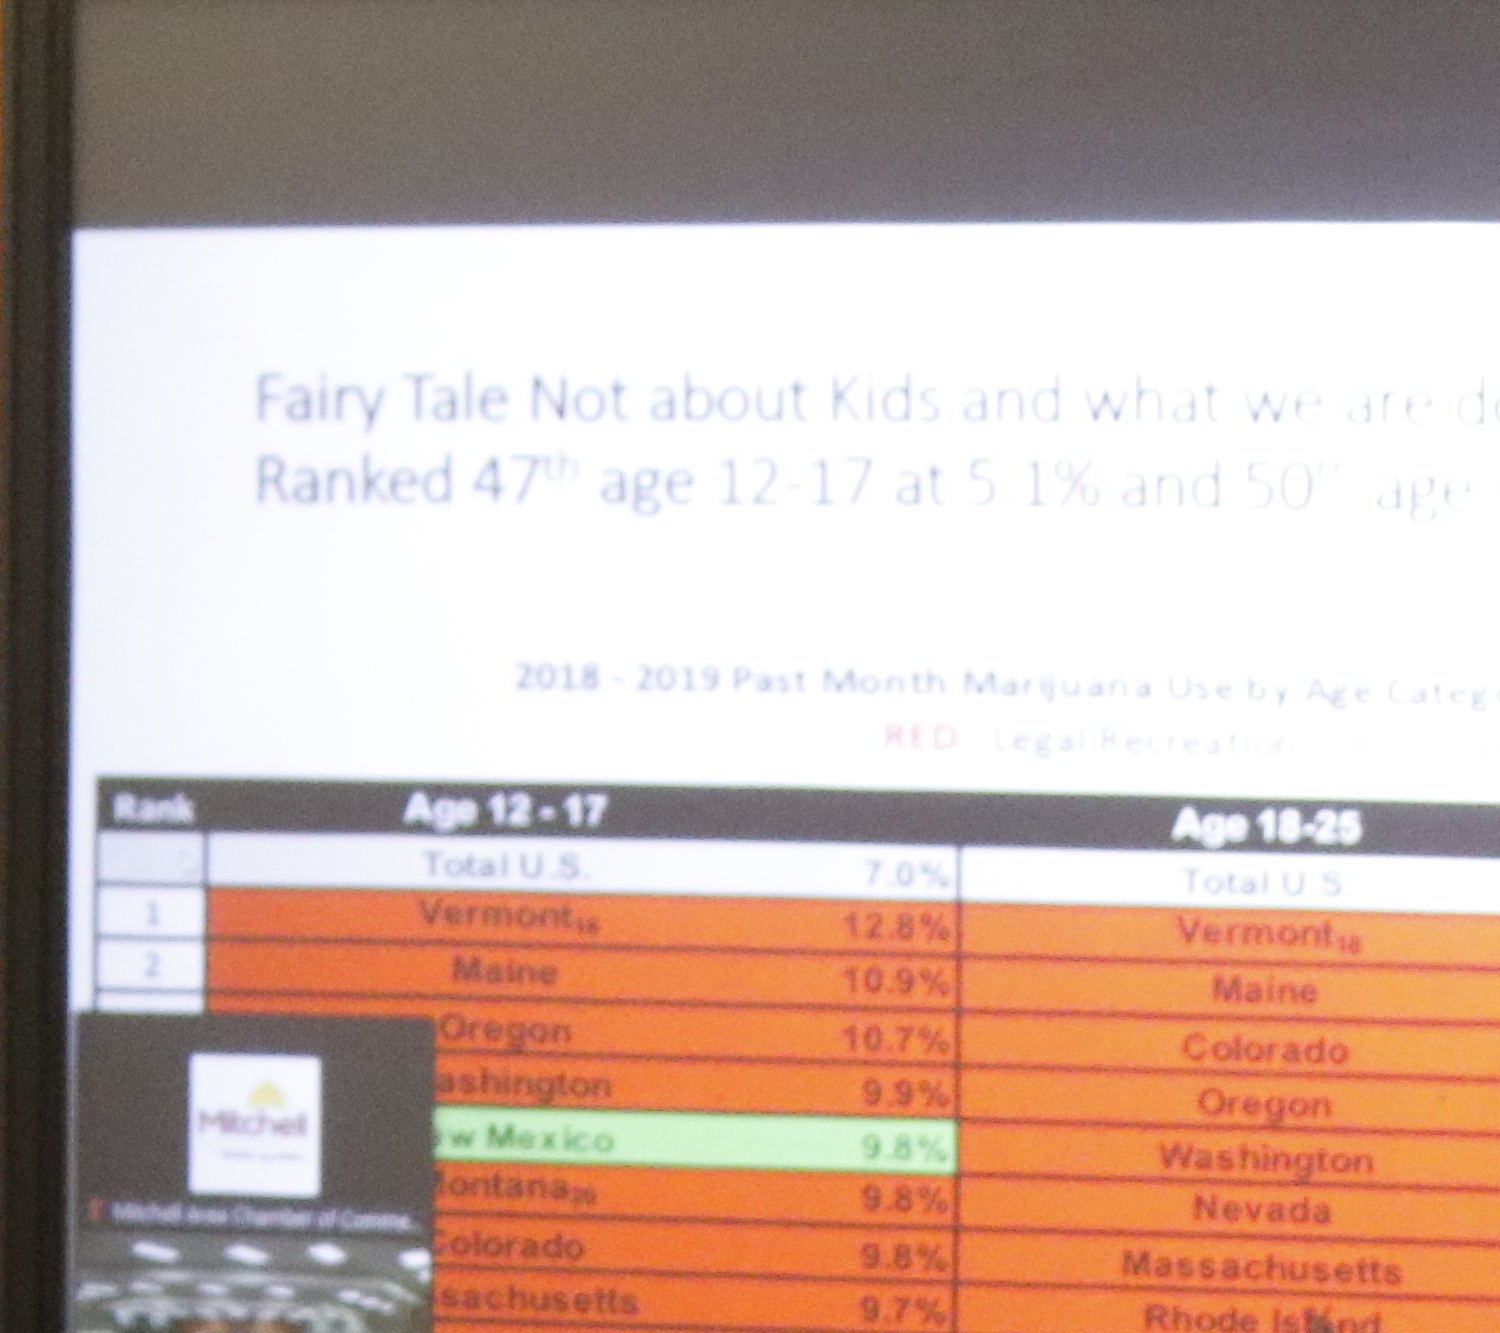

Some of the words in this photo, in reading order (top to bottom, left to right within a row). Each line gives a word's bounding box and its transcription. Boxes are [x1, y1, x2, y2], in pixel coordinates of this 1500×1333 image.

[253, 370, 387, 435] Fairy
[402, 371, 510, 424] Tale
[530, 373, 631, 424] Not
[649, 371, 808, 425] about
[829, 372, 942, 425] Kids
[960, 376, 1062, 425] and
[1084, 375, 1221, 426] what
[1242, 387, 1325, 427] we
[1345, 387, 1436, 427] are
[253, 452, 456, 508] Ranked
[472, 452, 581, 507] 47th
[599, 463, 697, 517] age
[717, 455, 874, 508] 12-17
[893, 459, 945, 508] at
[965, 455, 1101, 510] 5.1%
[1120, 456, 1222, 510] and
[1374, 474, 1473, 524] age
[514, 660, 602, 692] 2018
[634, 662, 722, 694] 2019
[731, 664, 808, 695] Past
[821, 666, 948, 697] Month
[961, 668, 1153, 705] Marijuana
[1166, 675, 1234, 702] Use
[1246, 674, 1292, 707] by
[1305, 676, 1373, 711] Age
[882, 721, 960, 752] RED
[112, 792, 195, 825] Rank
[403, 793, 480, 830] Age
[488, 794, 532, 826] 12
[565, 795, 608, 828] 17
[1171, 808, 1249, 850] Age
[1256, 809, 1363, 846] 18-25
[422, 851, 511, 879] Total
[866, 860, 953, 891] 7.0%
[1181, 866, 1269, 896] Total
[144, 901, 161, 927] 1
[842, 911, 953, 942] 12.8%
[451, 956, 558, 987] Maine
[842, 966, 952, 997] 10.9%
[1211, 973, 1320, 1006] Maine
[439, 1015, 573, 1052] Oregon
[842, 1025, 951, 1056] 10.7%
[1181, 1031, 1350, 1066] Colorado
[435, 1069, 613, 1107] ashington
[862, 1077, 951, 1107] 9.9%
[1198, 1086, 1333, 1125] Oregon
[483, 1123, 616, 1155] Mexico
[861, 1133, 951, 1163] 9.8%
[1158, 1141, 1375, 1184] Washington
[860, 1183, 949, 1215] 9.8%
[1192, 1193, 1333, 1226] Nevada
[860, 1240, 949, 1272] 9.8%
[1121, 1249, 1403, 1287] Massachusetts
[438, 1284, 640, 1317] sachusetts
[859, 1294, 948, 1325] 9.7%
